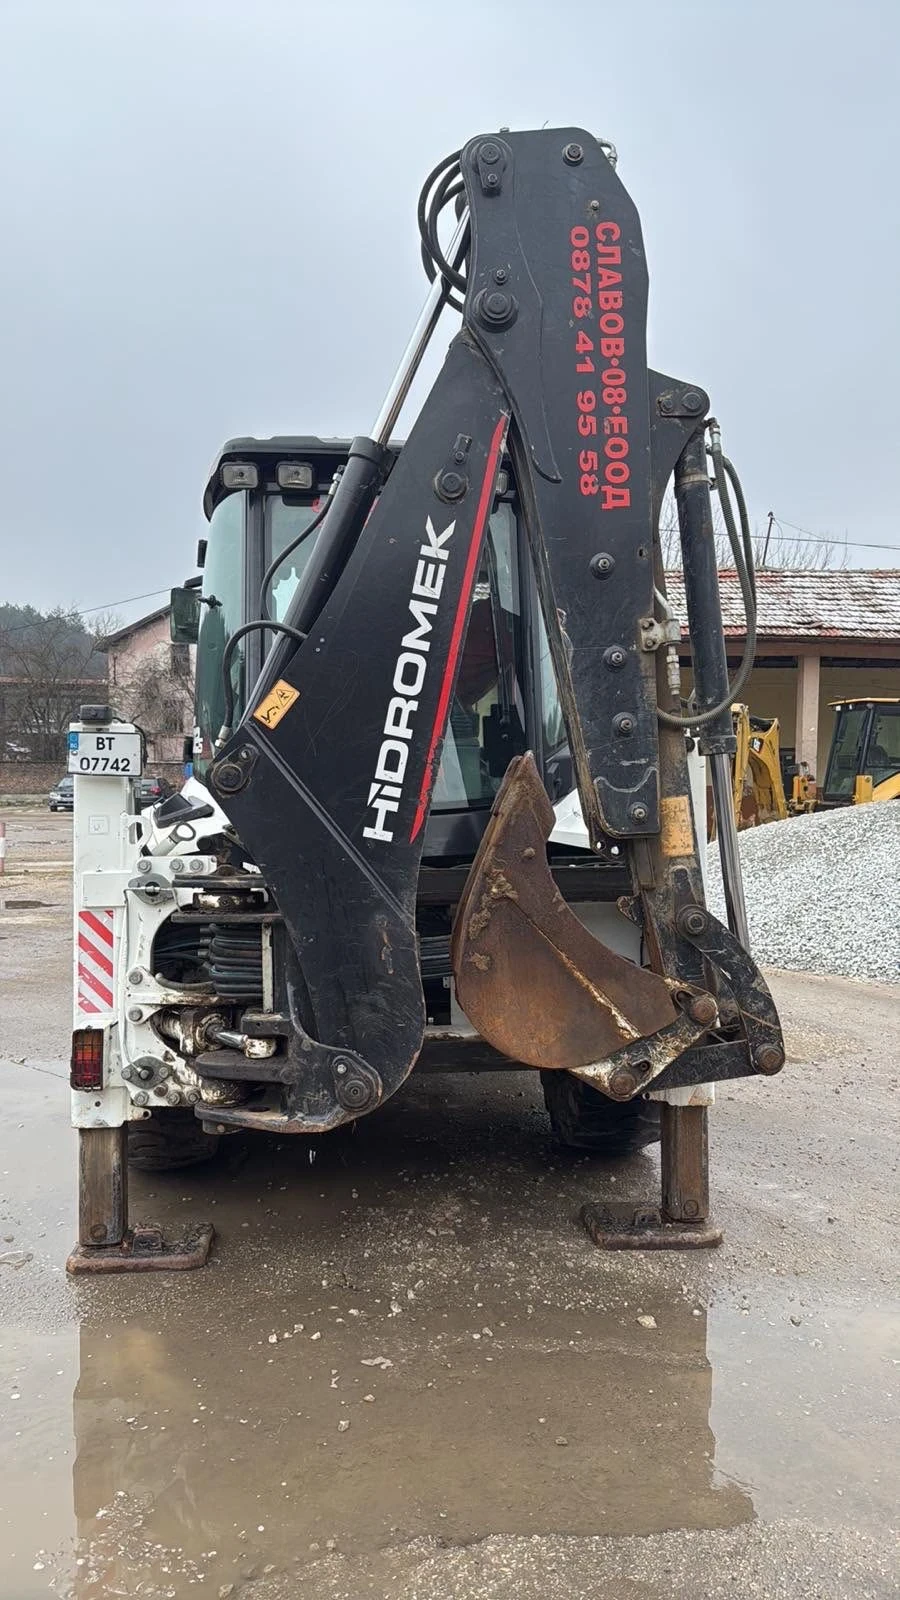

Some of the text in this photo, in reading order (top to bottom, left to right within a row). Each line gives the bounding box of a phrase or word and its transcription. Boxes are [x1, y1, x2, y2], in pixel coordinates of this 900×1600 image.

[570, 225, 599, 496] 0878 41 95 58
[96, 737, 115, 750] BT
[79, 757, 130, 772] 07742
